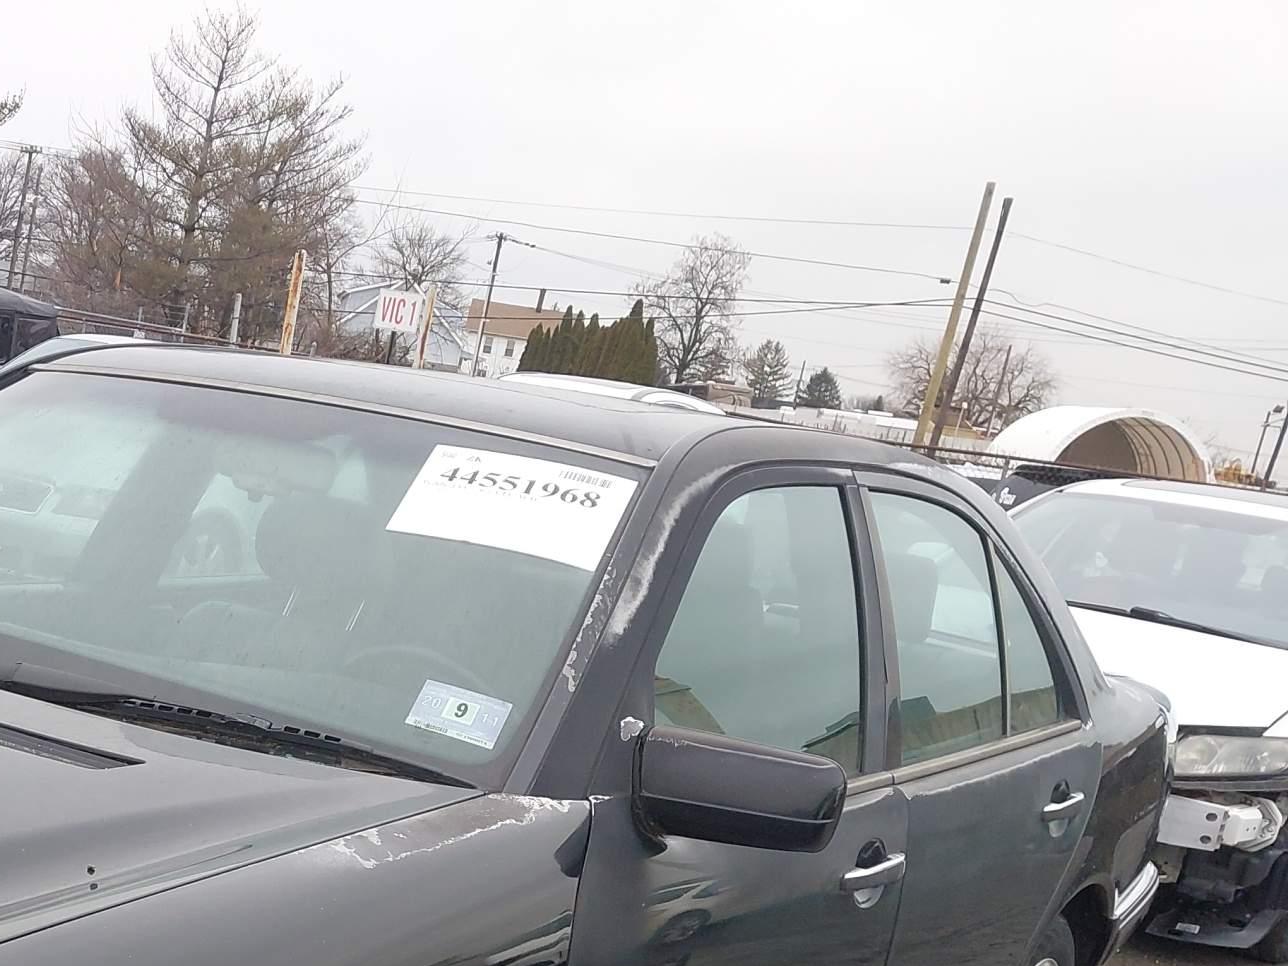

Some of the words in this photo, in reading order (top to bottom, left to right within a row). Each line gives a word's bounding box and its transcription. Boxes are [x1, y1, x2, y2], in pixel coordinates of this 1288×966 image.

[381, 296, 406, 325] VIC
[409, 301, 417, 326] 1
[440, 467, 601, 508] 44551968
[454, 703, 469, 718] 9
